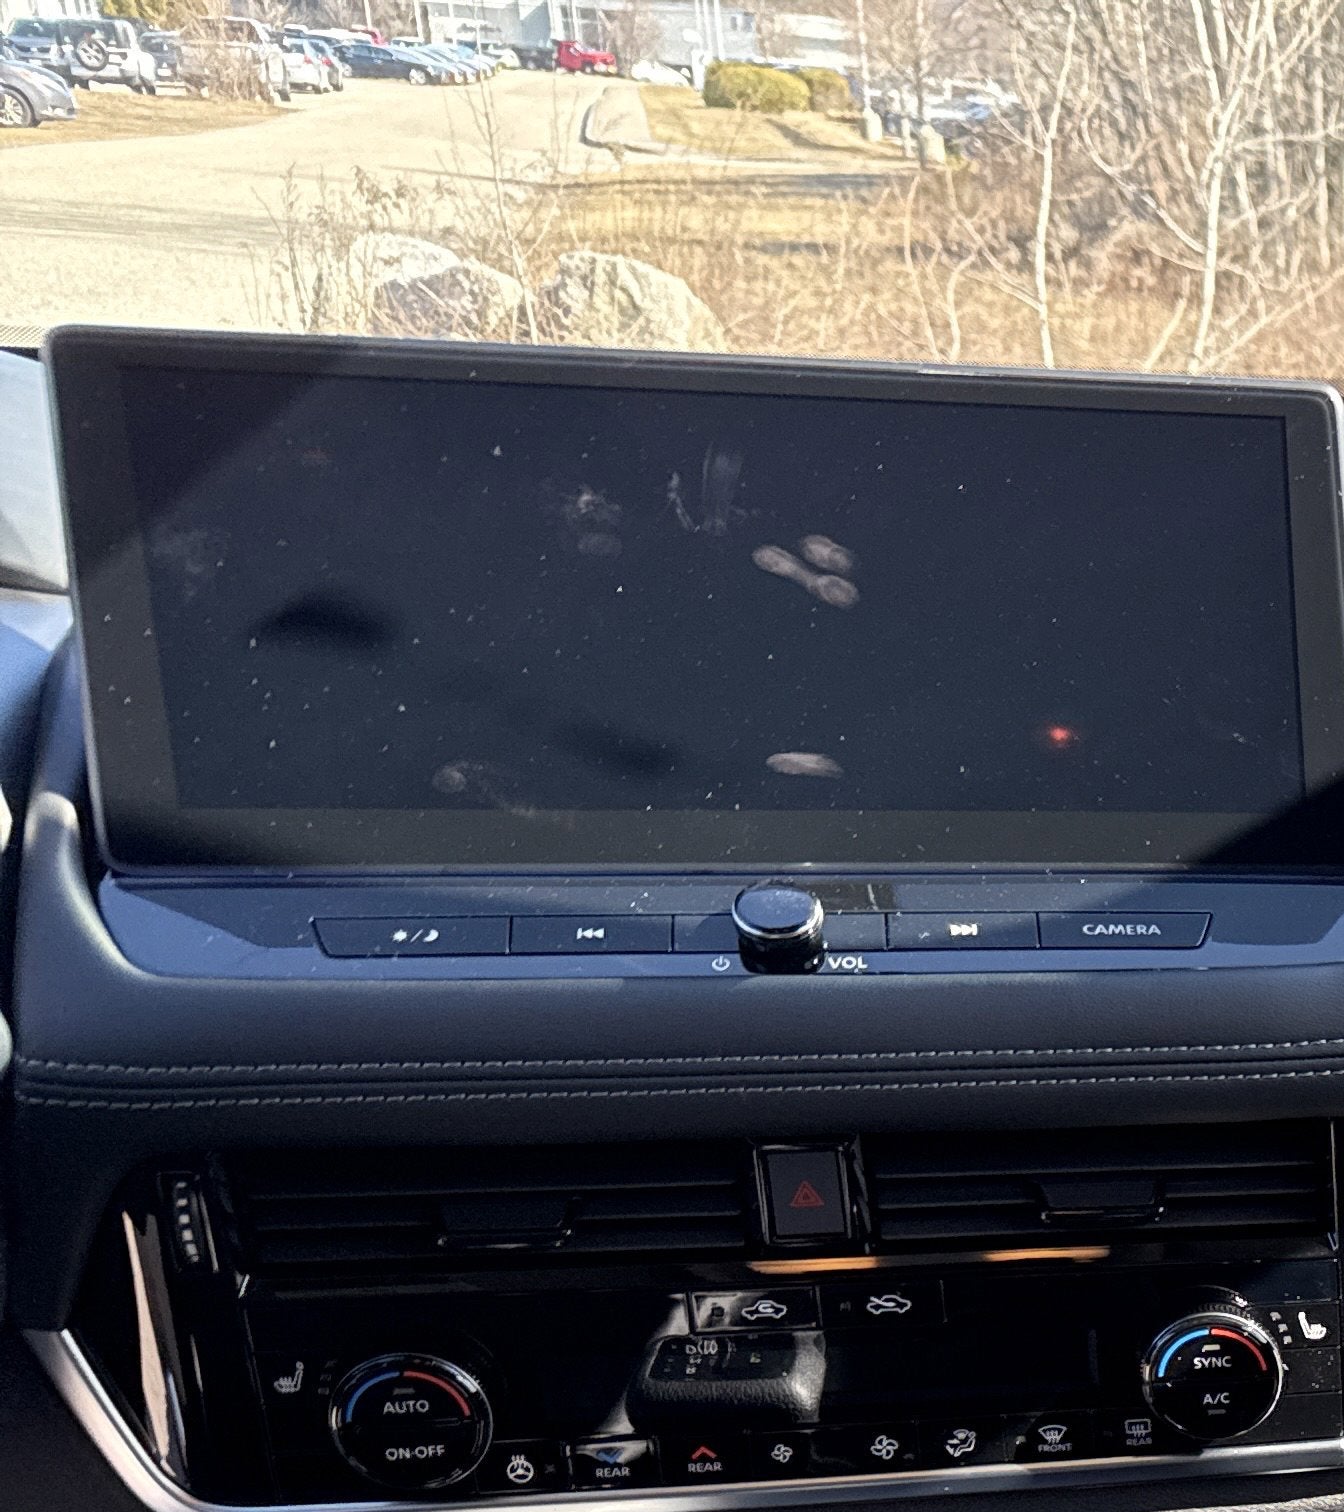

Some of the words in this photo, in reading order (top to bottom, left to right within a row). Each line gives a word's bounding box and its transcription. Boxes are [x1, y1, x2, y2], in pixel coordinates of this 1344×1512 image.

[1082, 924, 1161, 935] CAMERA
[828, 956, 868, 969] VOL
[1193, 1355, 1232, 1370] SYNC
[1203, 1392, 1230, 1405] A/C
[383, 1400, 429, 1415] AUTO
[1038, 1442, 1072, 1452] FRONT
[595, 1466, 631, 1478] REAR
[688, 1461, 722, 1473] REAR
